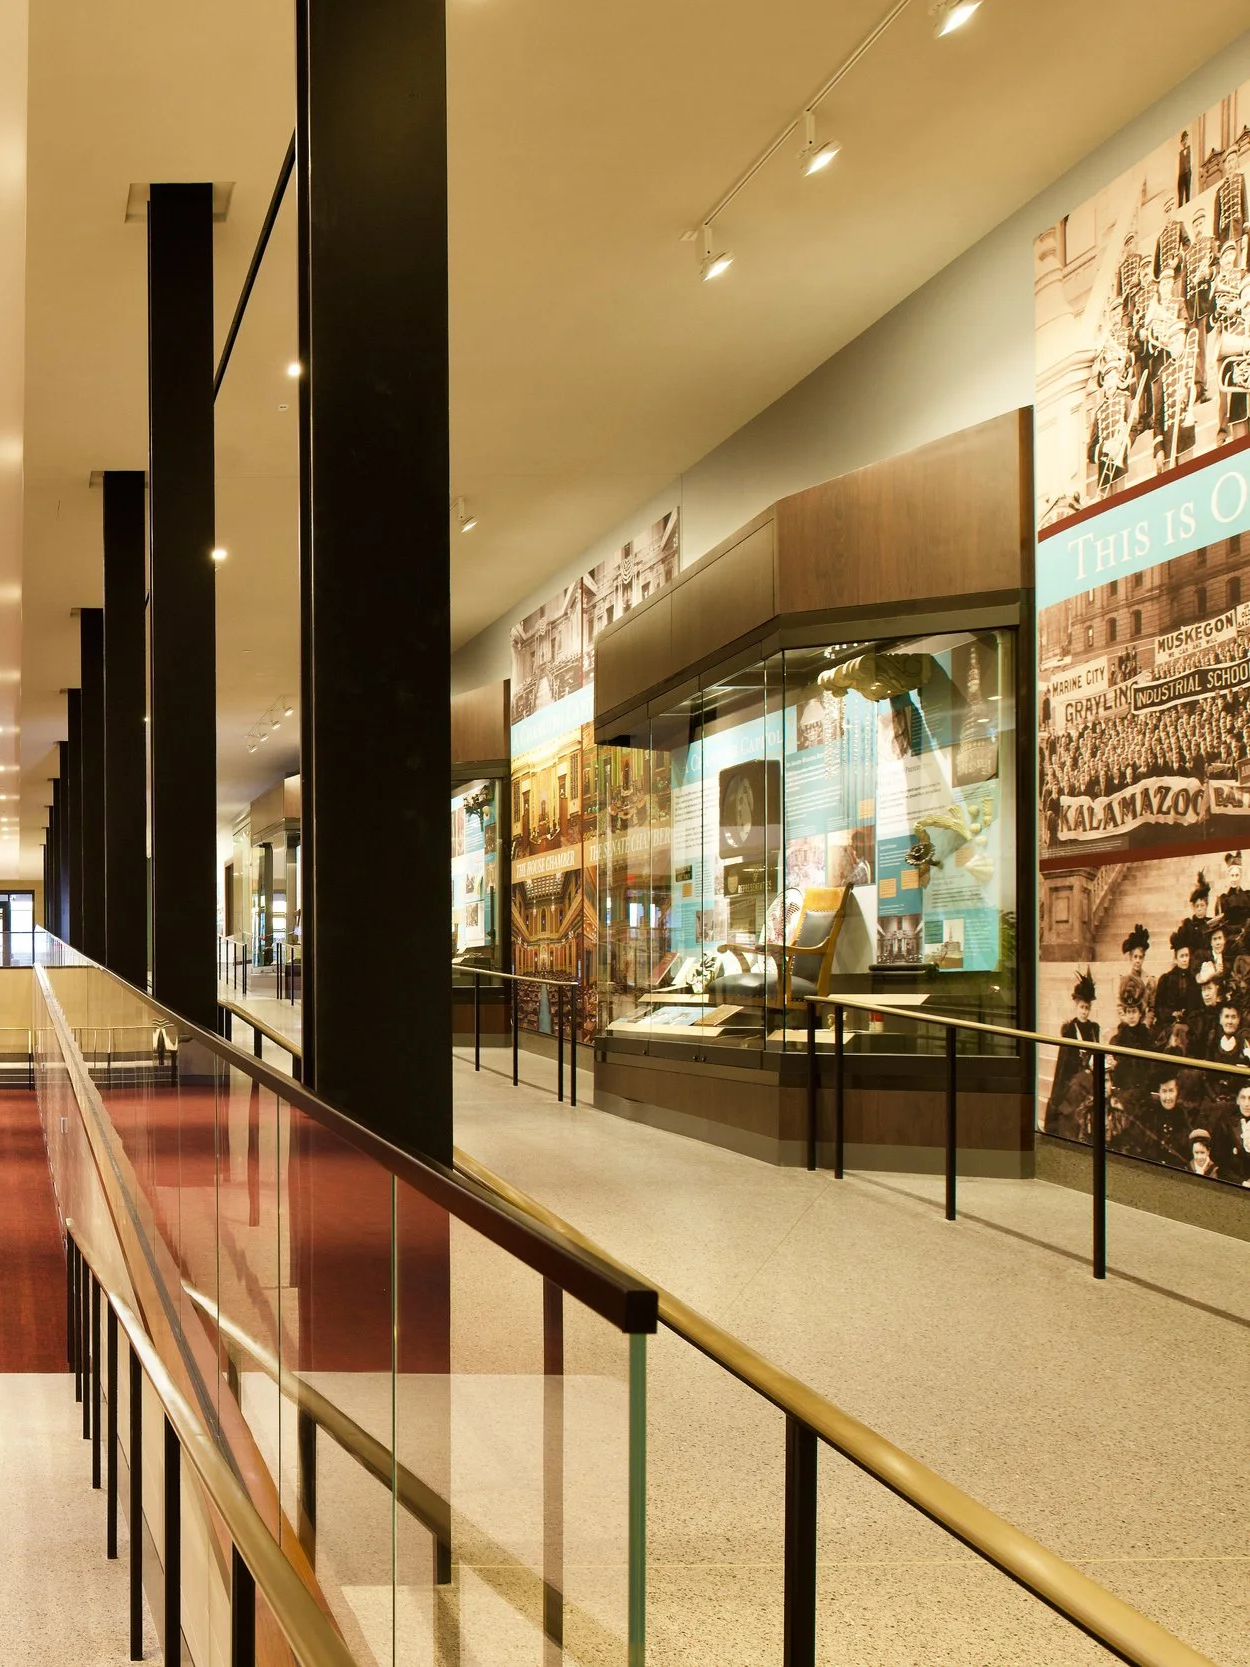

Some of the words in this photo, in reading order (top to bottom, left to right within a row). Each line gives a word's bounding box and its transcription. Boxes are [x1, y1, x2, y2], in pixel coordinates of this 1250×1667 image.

[1068, 519, 1151, 582] THIS
[1163, 500, 1197, 546] IS
[1157, 612, 1234, 654] MUSKEGON
[1052, 674, 1082, 697] MARINE
[1086, 666, 1105, 685] CITY
[1136, 674, 1202, 708] INDUSTRIAL
[1206, 661, 1250, 689] SCHOO
